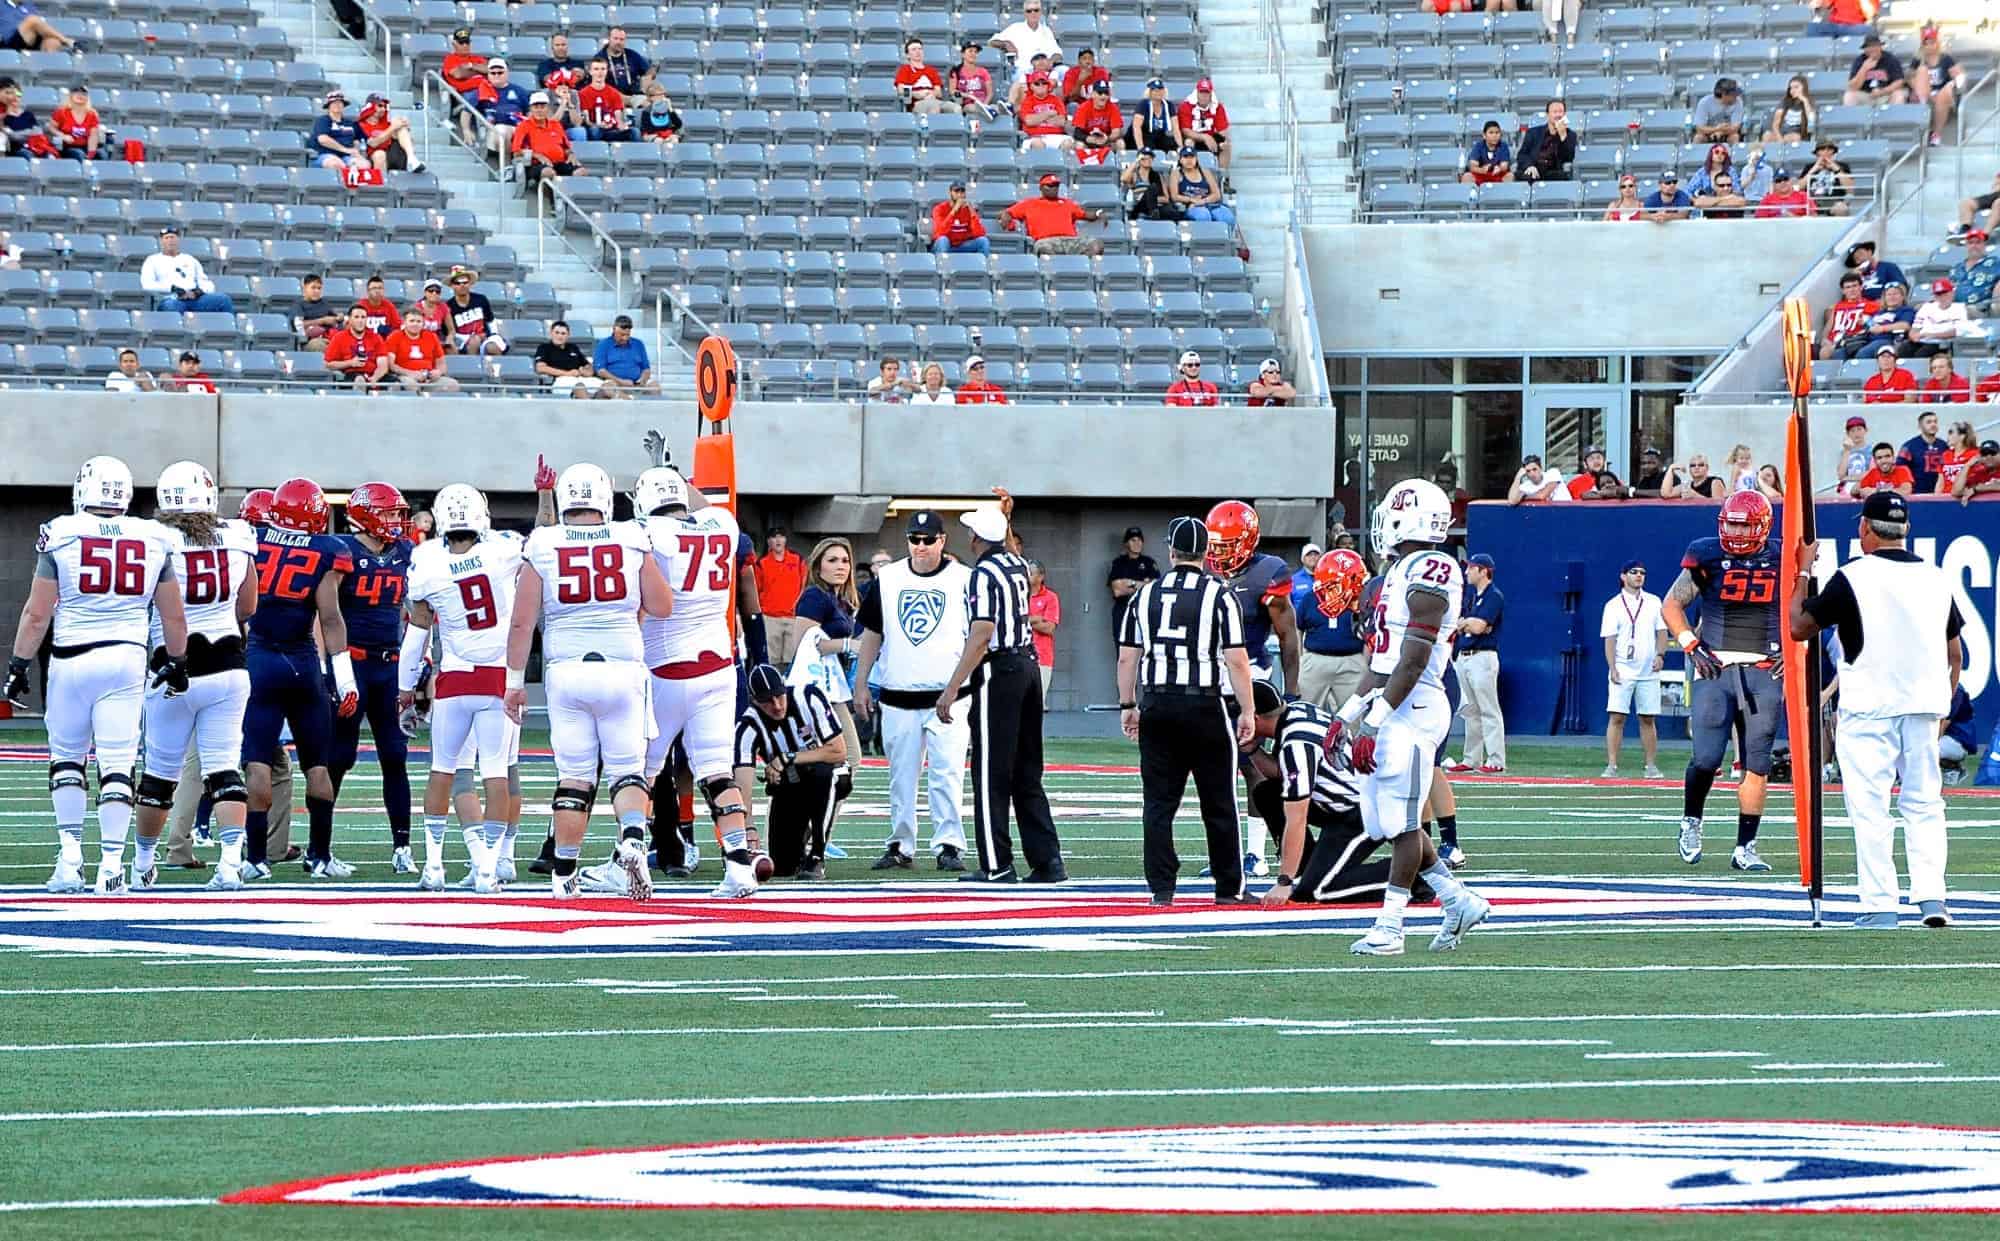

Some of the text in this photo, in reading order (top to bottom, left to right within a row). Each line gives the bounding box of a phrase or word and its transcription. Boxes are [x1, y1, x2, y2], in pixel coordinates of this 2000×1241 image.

[264, 530, 312, 547] MILLER
[79, 537, 146, 595] 56
[181, 548, 230, 605] 61
[449, 556, 483, 575] MARKS
[555, 544, 627, 604] 58
[676, 534, 732, 592] 73
[1421, 558, 1452, 585] 23
[355, 575, 403, 605] 47
[454, 574, 498, 631] 9
[1719, 569, 1777, 603] 55
[908, 617, 929, 634] 12
[1156, 593, 1187, 640] L
